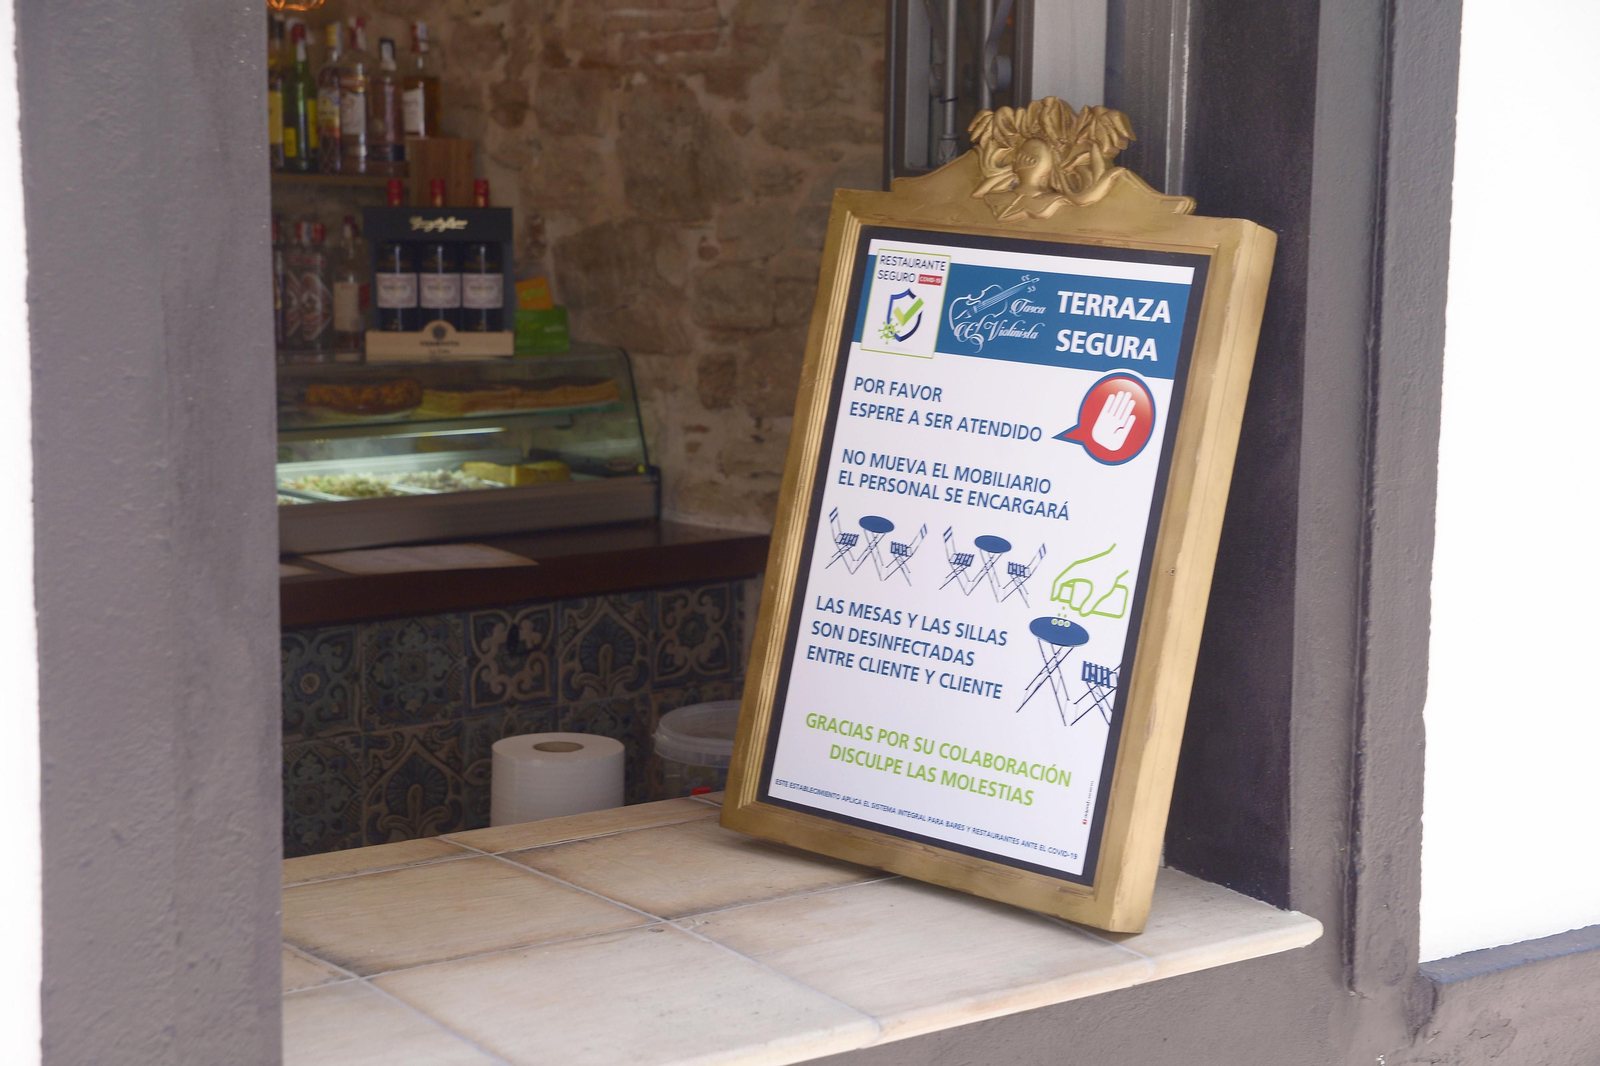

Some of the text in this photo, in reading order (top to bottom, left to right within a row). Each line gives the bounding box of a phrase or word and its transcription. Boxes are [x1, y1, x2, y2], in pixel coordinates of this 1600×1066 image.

[878, 270, 916, 282] SEGURO
[879, 254, 946, 271] RESTAURANTE
[1057, 290, 1171, 323] TERRAZA
[1055, 329, 1158, 362] SEGURA
[854, 376, 943, 402] POR FAVOR
[850, 402, 1042, 442] ESPERE A SER ATENDIDO
[842, 449, 1052, 494] NO MUEVA EL MOBILIARIO
[838, 470, 1070, 520] EL PERSONAL SE ENCARGARÁ
[811, 620, 974, 666] SON DESINFECTADAS
[816, 596, 1008, 646] LAS MESAS Y LAS SILLAS
[807, 645, 1003, 700] ENTRE CLIENTE Y CLIENTE
[806, 712, 1072, 788] GRACIAS POR SU COLABORACIÓN
[830, 744, 1034, 806] DISCULPE LAS MOLESTIAS
[775, 778, 789, 788] ESTE
[789, 782, 840, 800] ESTABLECIMIENTO
[842, 795, 862, 806] APLICA
[871, 802, 896, 814] SISTEMA
[898, 809, 926, 822] INTEGRAL
[928, 816, 944, 826] PARA
[946, 820, 965, 832] BARES
[972, 827, 1020, 845] RESTAURANTES
[1021, 840, 1038, 850] ANTE
[1048, 847, 1078, 860] COVID-19
